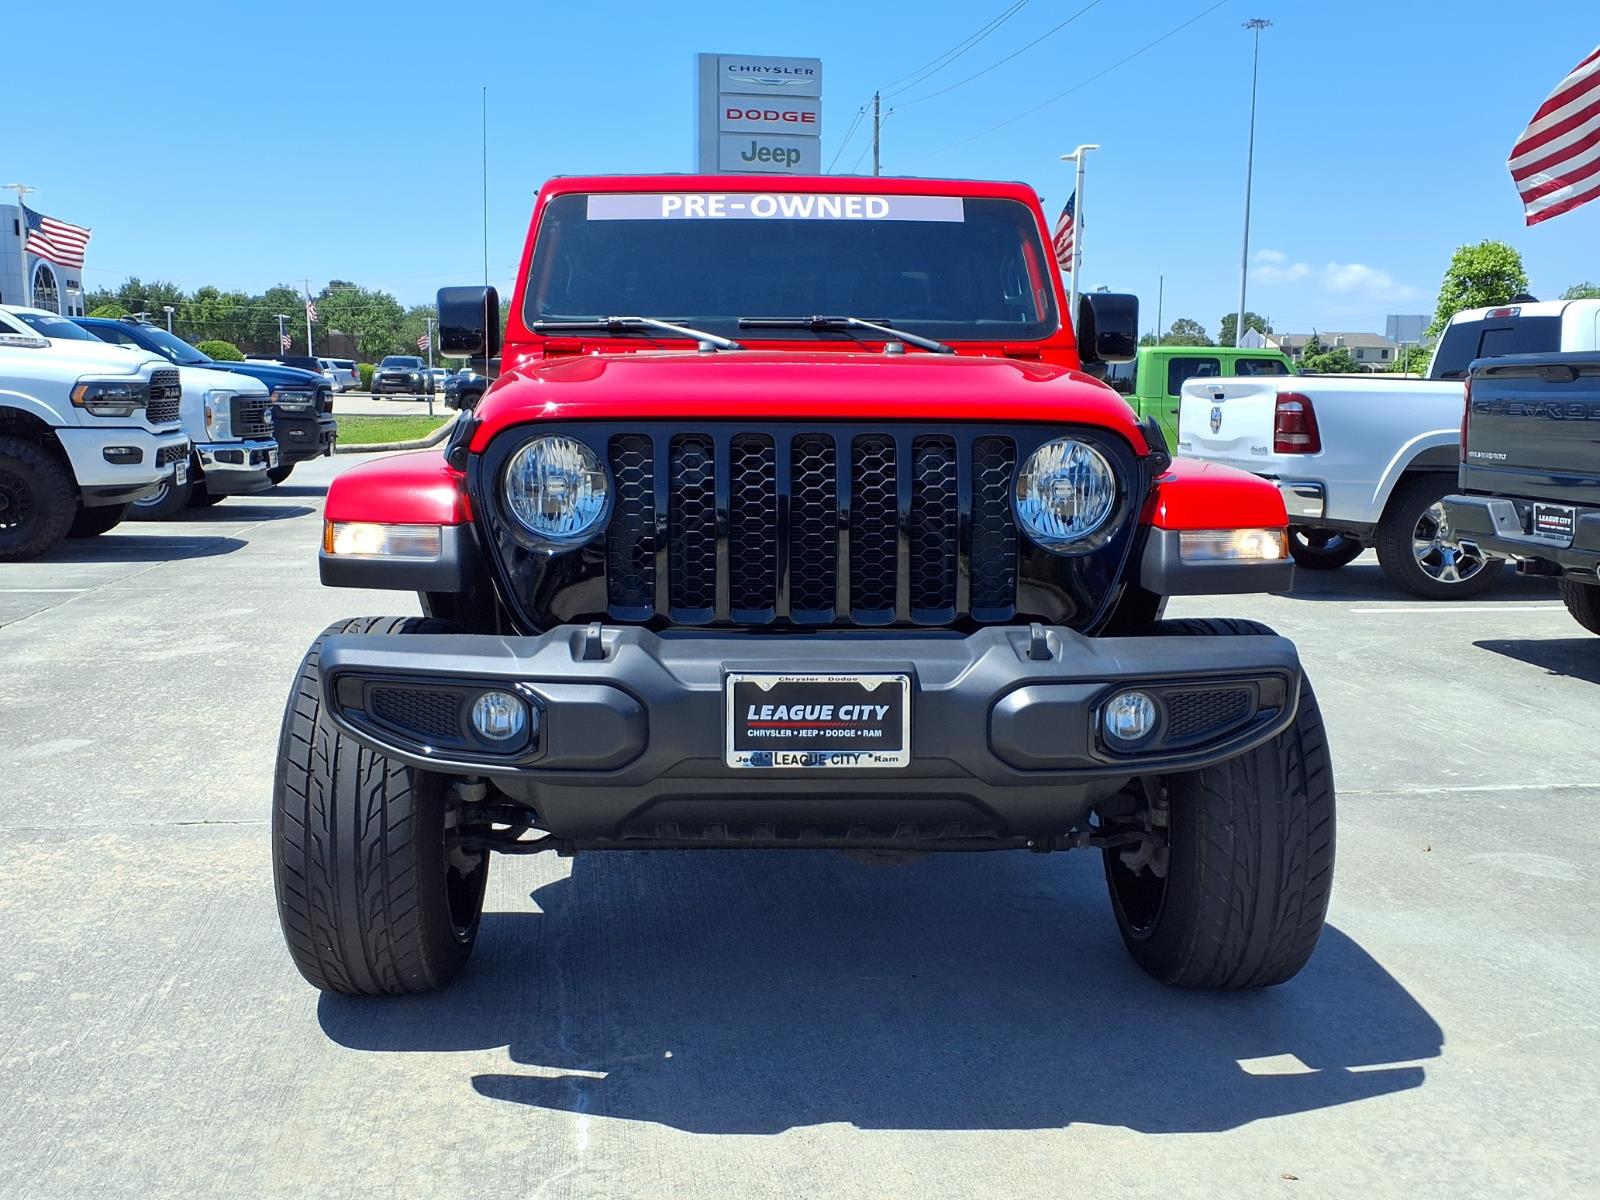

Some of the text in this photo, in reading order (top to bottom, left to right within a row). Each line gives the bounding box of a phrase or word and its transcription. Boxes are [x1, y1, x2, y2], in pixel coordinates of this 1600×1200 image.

[728, 65, 814, 75] CHRYSLER
[726, 108, 816, 123] DODGE
[741, 140, 801, 168] Jeep
[661, 194, 890, 218] PRE-OWNED
[1538, 514, 1572, 526] LEAGUE CITY
[747, 704, 890, 721] LEAGUE CITY
[747, 729, 882, 737] CHRYSLER JEEP DODGE RAM
[774, 752, 827, 766] LEAGUE
[831, 753, 861, 766] CITY
[874, 755, 899, 763] Ram
